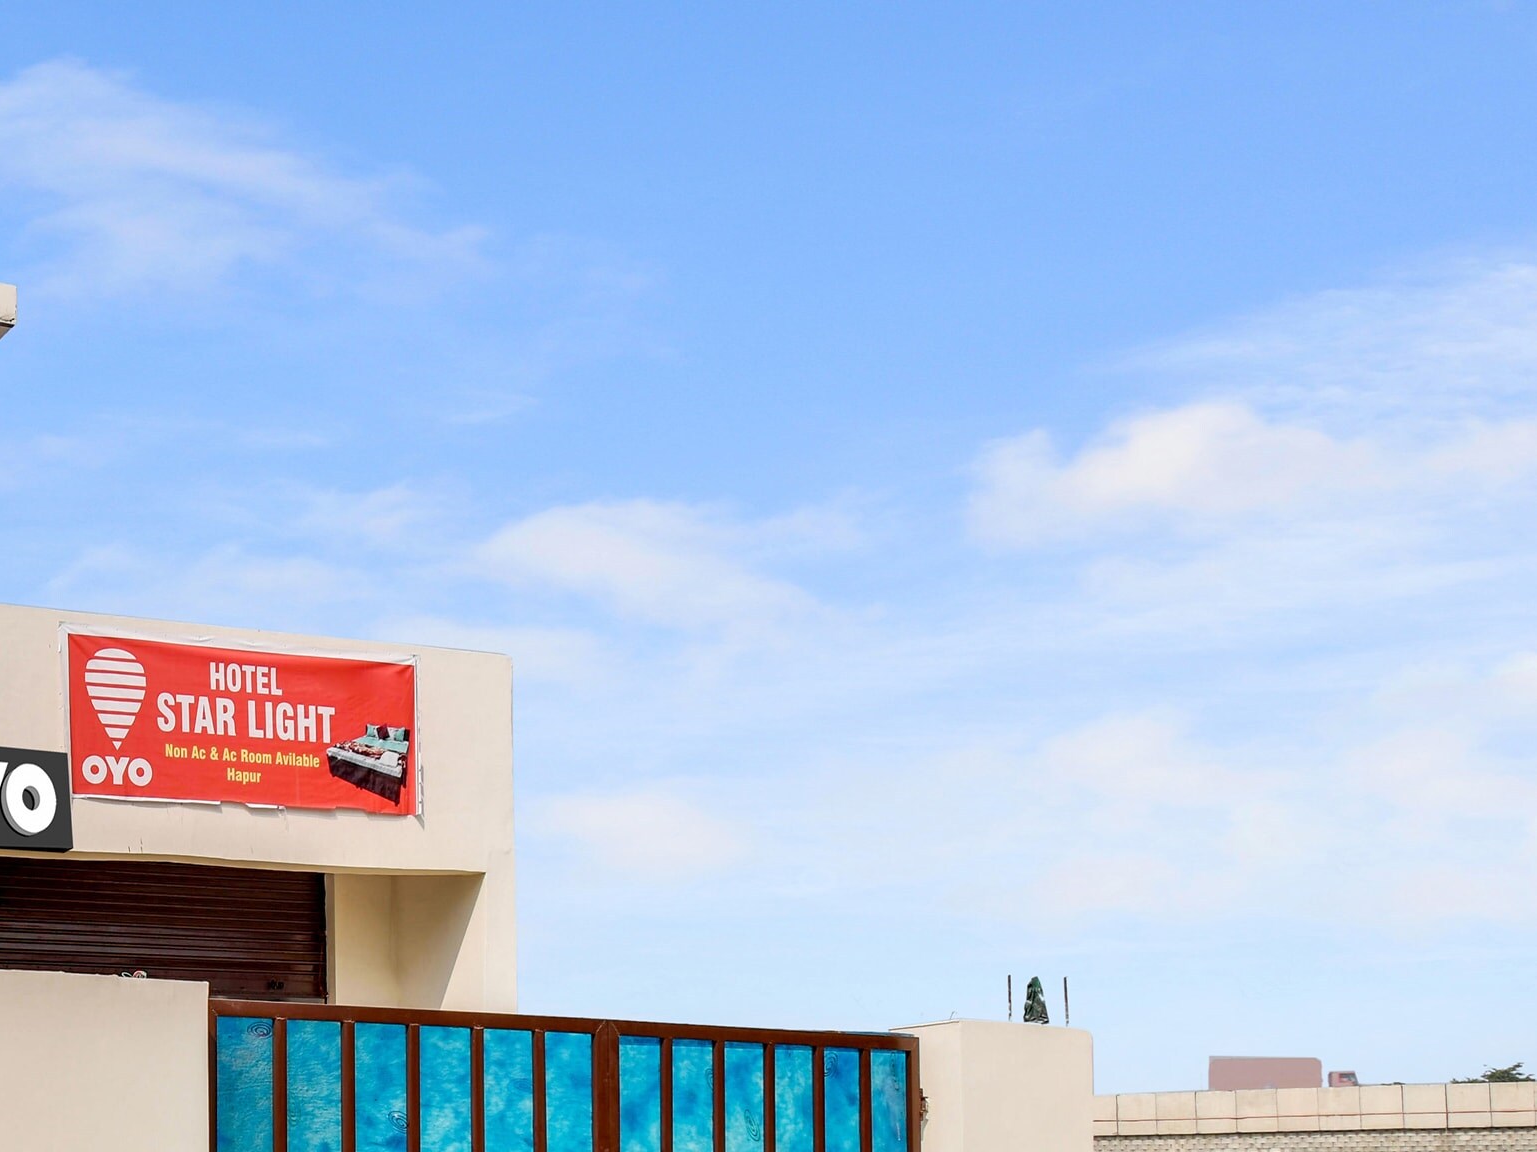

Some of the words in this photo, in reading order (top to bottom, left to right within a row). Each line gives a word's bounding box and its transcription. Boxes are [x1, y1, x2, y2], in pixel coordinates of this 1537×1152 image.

[209, 661, 283, 696] HOTEL
[156, 692, 236, 737] STAR
[247, 699, 336, 744] LIGHT
[81, 755, 153, 787] OYO
[165, 743, 188, 759] Non
[191, 745, 207, 760] Ac
[209, 746, 219, 761] &
[222, 747, 238, 762] Ac
[241, 748, 273, 765] Room
[275, 751, 321, 768] Avilable
[226, 767, 262, 783] Hapur
